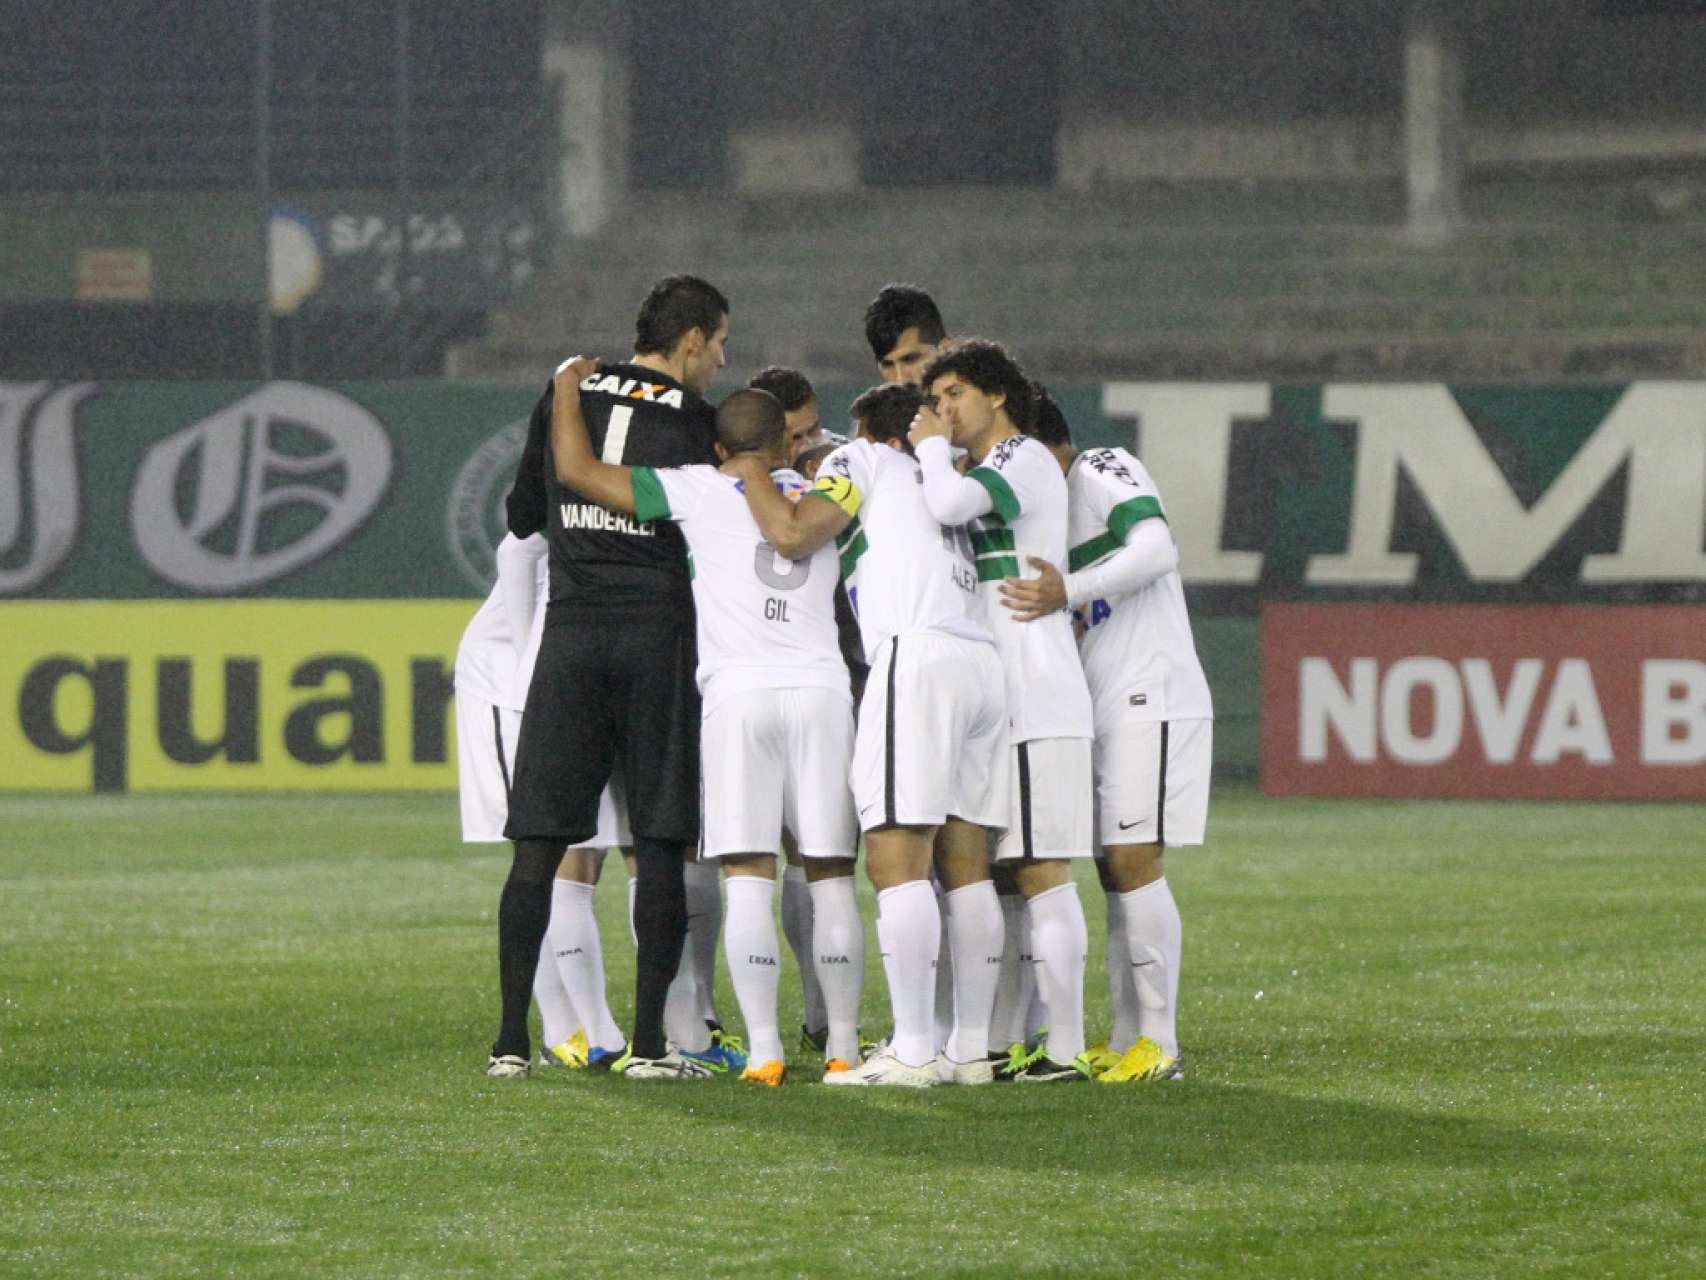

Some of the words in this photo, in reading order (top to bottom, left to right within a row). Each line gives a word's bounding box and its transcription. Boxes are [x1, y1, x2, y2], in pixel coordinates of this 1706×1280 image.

[580, 373, 683, 408] CAIXA
[603, 405, 633, 465] 1
[1104, 381, 1706, 585] IM
[764, 598, 791, 622] GIL
[1299, 657, 1613, 764] NOVA
